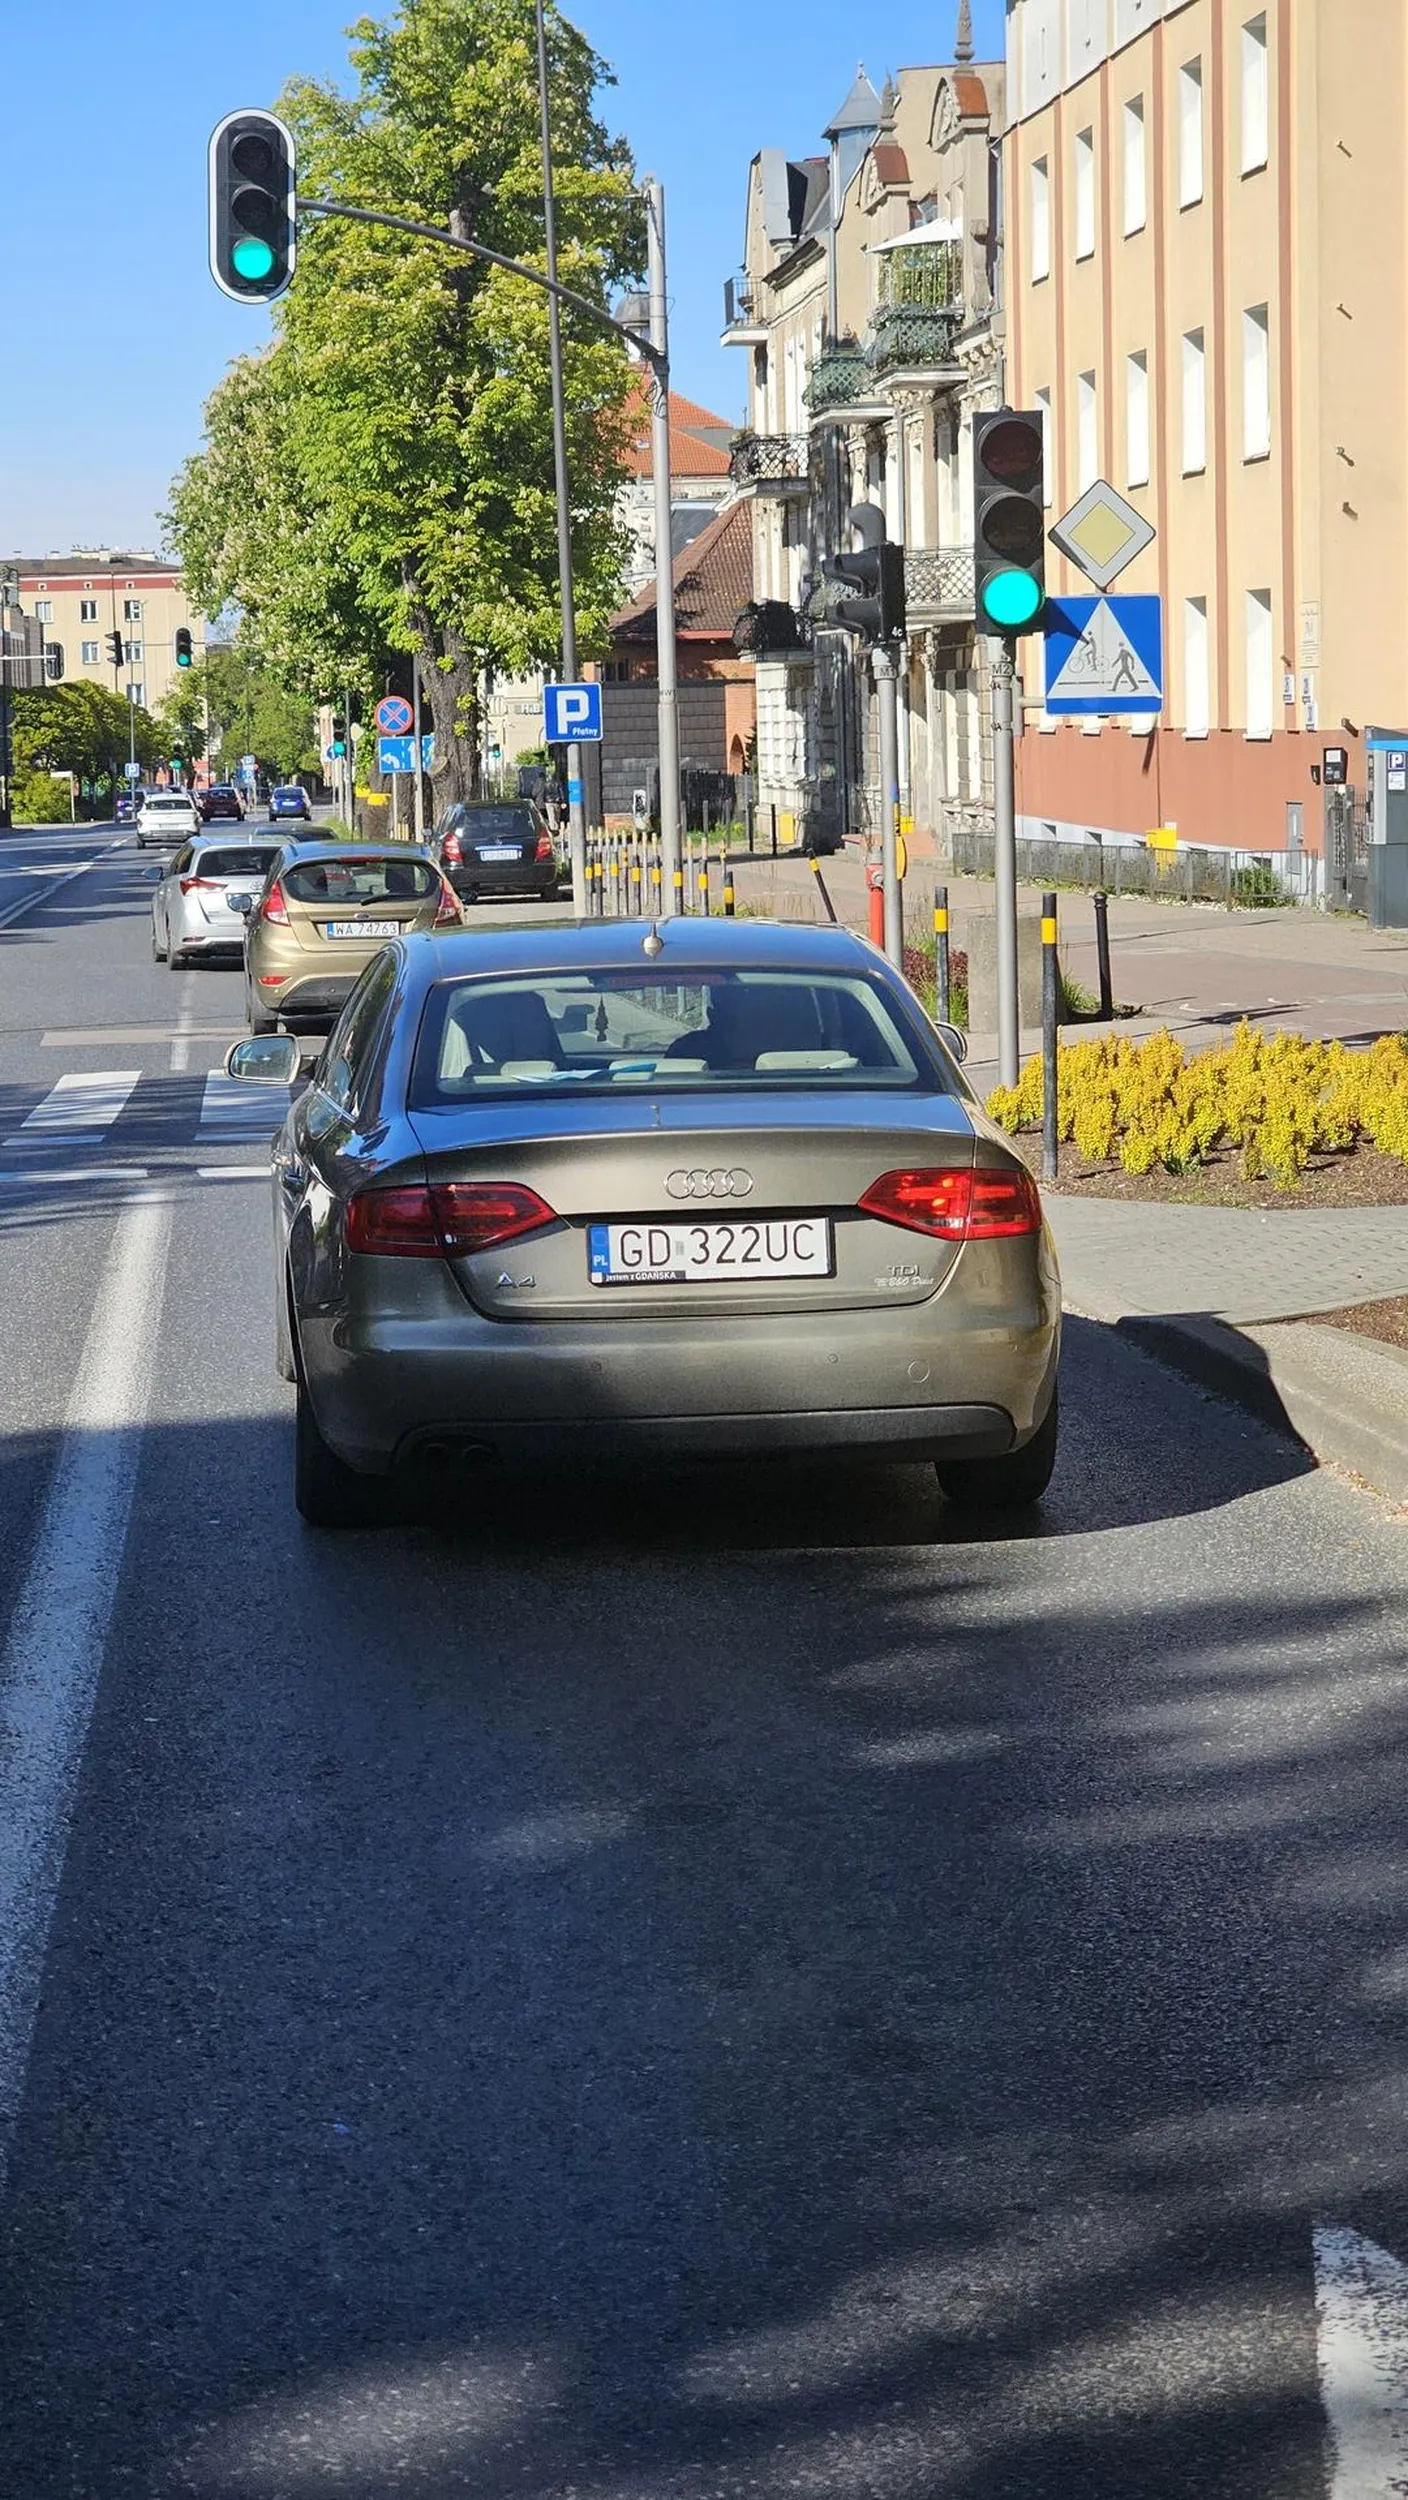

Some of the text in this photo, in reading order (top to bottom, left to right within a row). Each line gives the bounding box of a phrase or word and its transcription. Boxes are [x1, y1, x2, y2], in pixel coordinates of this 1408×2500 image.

[992, 665, 1010, 675] M2
[556, 690, 589, 734] P
[1391, 753, 1403, 768] P
[335, 923, 353, 935] WA
[620, 1224, 814, 1267] GD 322UC
[593, 1255, 608, 1267] PL
[887, 1264, 920, 1277] TDI
[496, 1271, 538, 1289] A4
